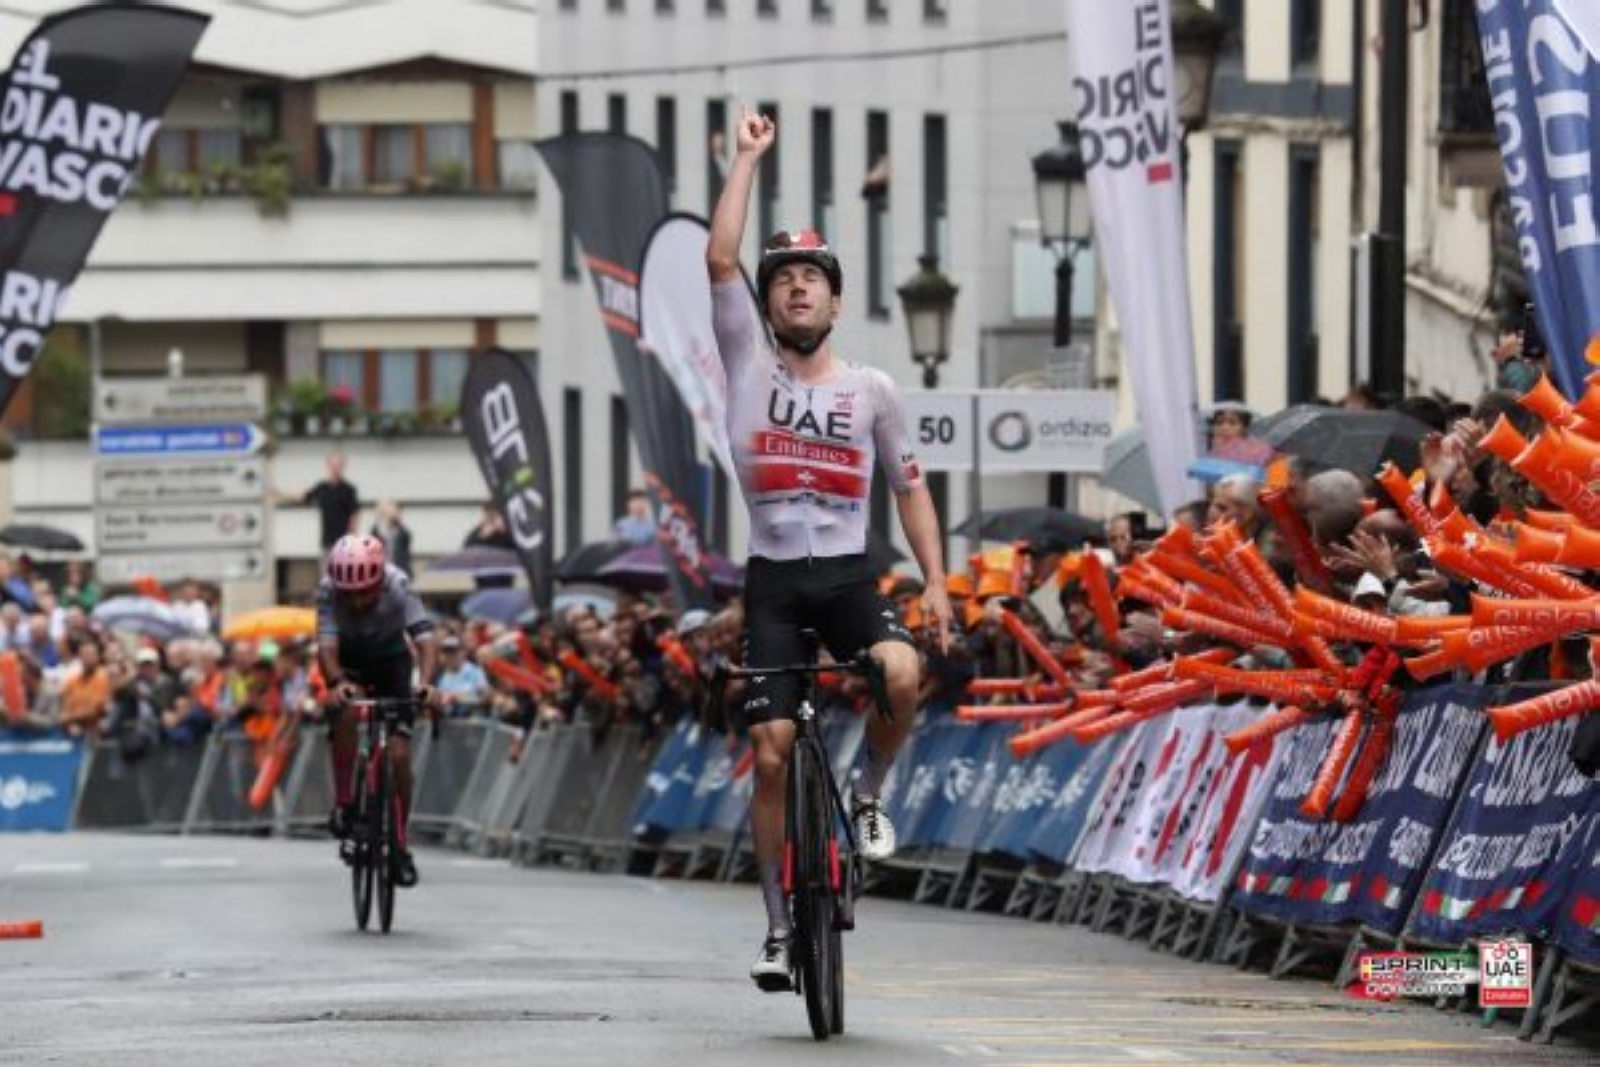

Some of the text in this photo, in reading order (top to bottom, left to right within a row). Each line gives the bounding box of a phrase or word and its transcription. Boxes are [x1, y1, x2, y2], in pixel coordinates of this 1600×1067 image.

[768, 387, 851, 441] UAE
[919, 415, 955, 445] 50
[765, 435, 850, 465] Emirates
